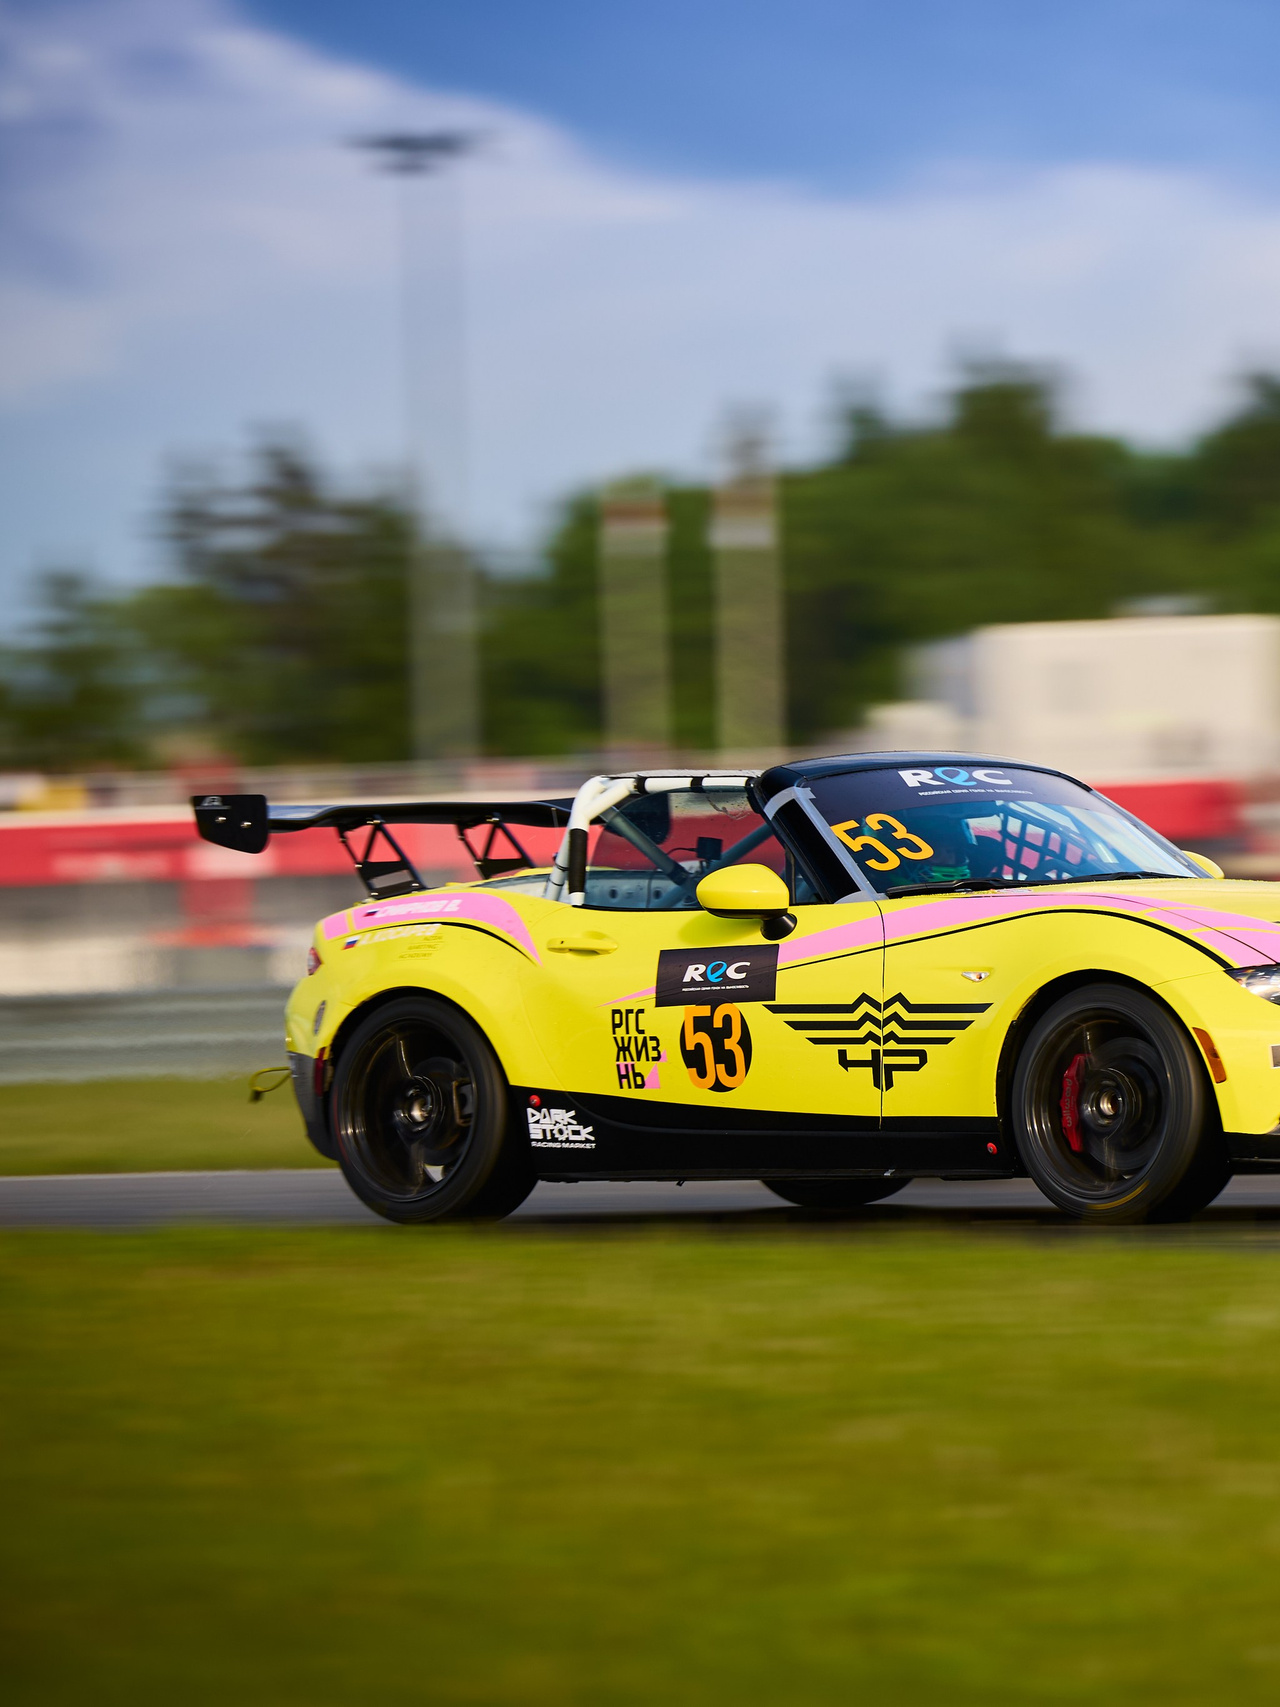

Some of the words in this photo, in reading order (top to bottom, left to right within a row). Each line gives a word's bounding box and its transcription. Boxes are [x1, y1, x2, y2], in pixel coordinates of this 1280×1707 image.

[829, 813, 934, 872] 53
[611, 1008, 645, 1035] РГС
[613, 1036, 662, 1062] ЖИЗ
[684, 1003, 746, 1089] 53
[616, 1063, 646, 1089] НЬ
[526, 1107, 578, 1125] DARK
[528, 1123, 596, 1141] STOCK
[530, 1141, 562, 1149] RACING
